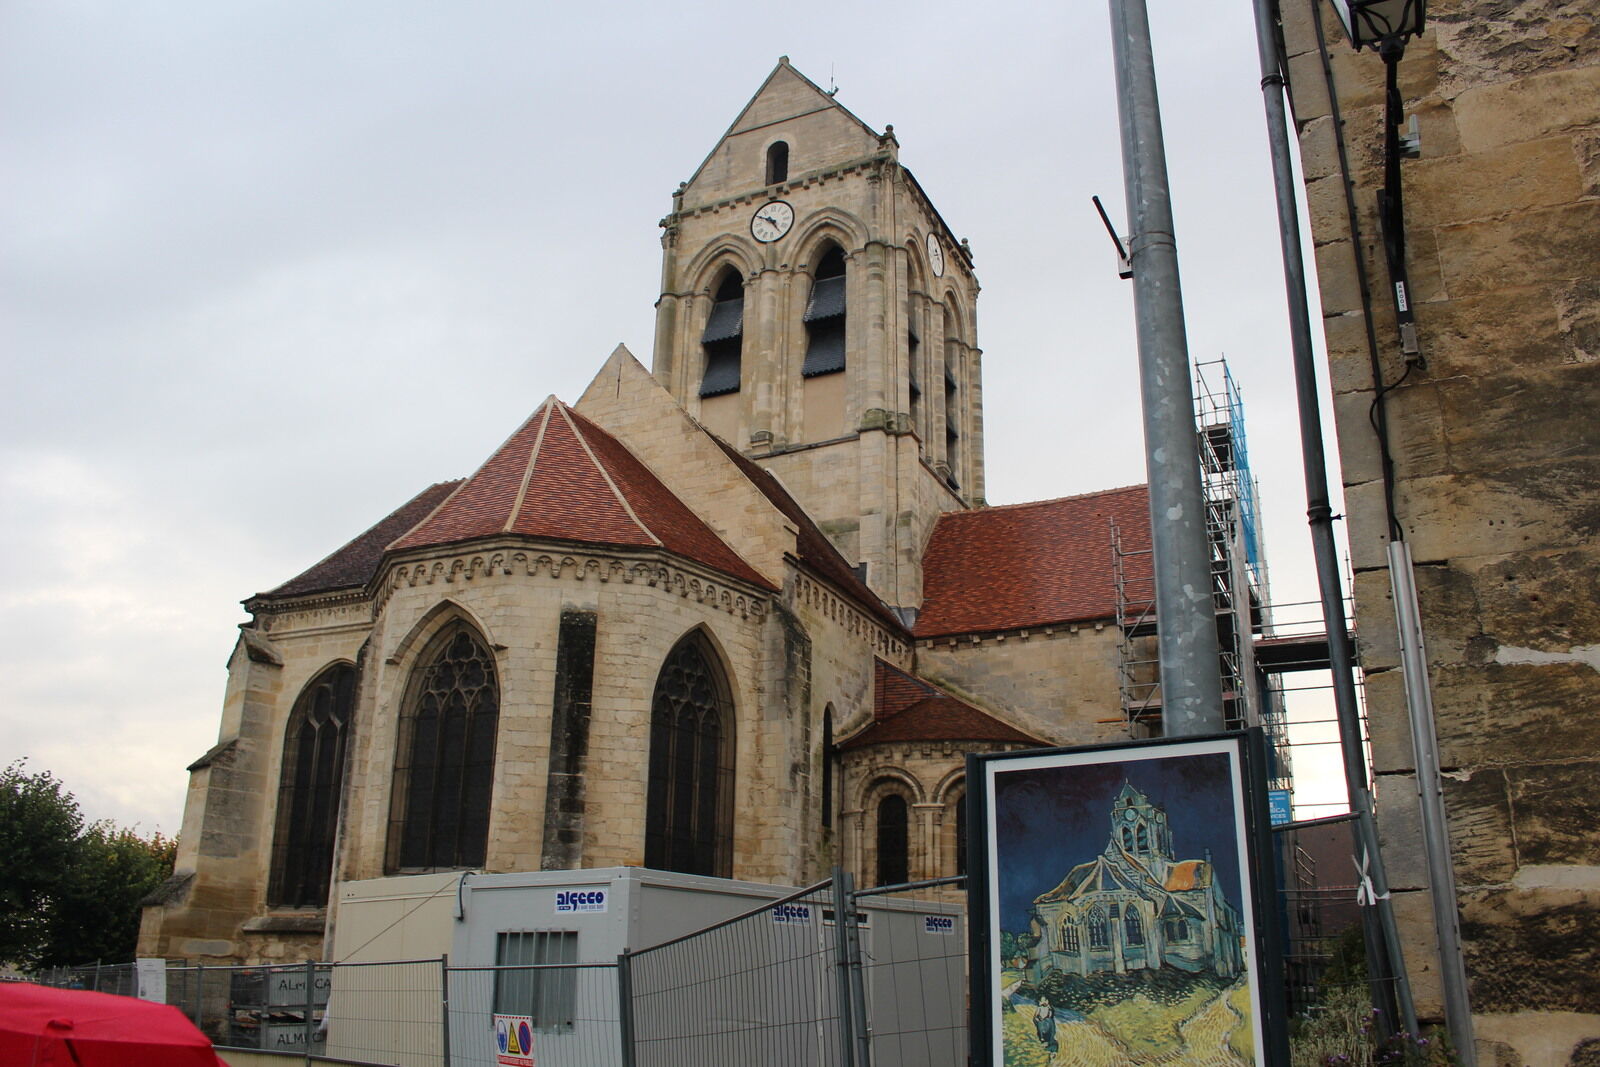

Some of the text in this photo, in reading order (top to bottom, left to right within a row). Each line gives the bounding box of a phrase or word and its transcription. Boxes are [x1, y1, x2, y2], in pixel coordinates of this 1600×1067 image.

[557, 891, 604, 911] algeco
[773, 905, 809, 922] algeco
[926, 916, 952, 932] algeco
